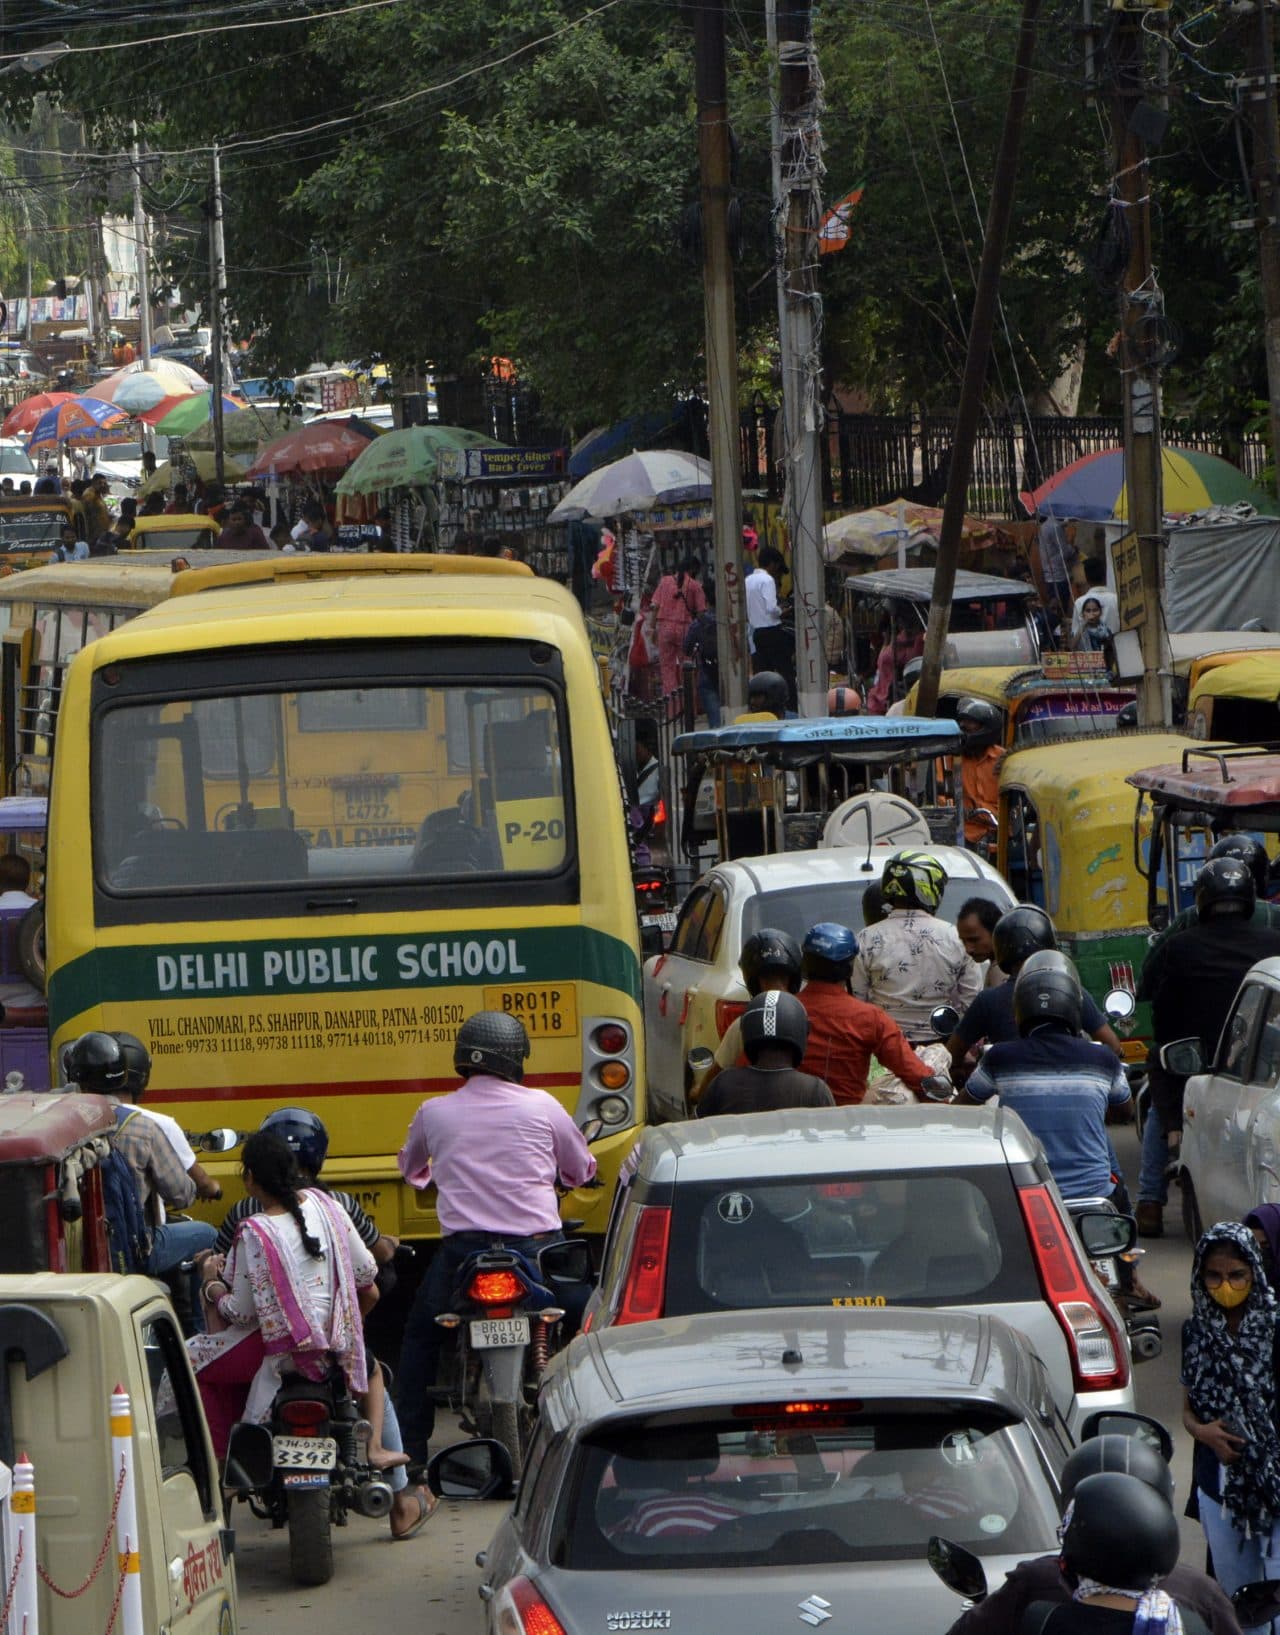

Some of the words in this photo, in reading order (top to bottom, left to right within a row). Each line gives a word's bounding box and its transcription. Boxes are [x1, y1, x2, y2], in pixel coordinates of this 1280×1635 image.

[505, 819, 564, 844] P-20
[157, 953, 248, 991] DELHI
[264, 946, 378, 986] PUBLIC
[397, 939, 526, 979] SCHOOL
[503, 991, 561, 1011] BR01P
[149, 1018, 175, 1037] VILL.
[177, 1015, 247, 1035] CHANDMARI,
[249, 1014, 265, 1033] P.S.
[267, 1011, 323, 1032] SHAHPUR,
[325, 1009, 380, 1029] DANAPUR,
[382, 1007, 418, 1026] PATNA
[151, 1041, 183, 1055] Phone:
[186, 1038, 218, 1053] 99733
[221, 1037, 255, 1053] 11118,
[257, 1035, 288, 1050] 99738
[291, 1034, 325, 1049] 11118,
[327, 1032, 359, 1047] 97714
[361, 1031, 396, 1046] 40118,
[398, 1029, 432, 1044] 97714
[482, 1320, 522, 1334] BR01D
[484, 1332, 525, 1345] Y8634
[278, 1449, 332, 1465] 3398
[284, 1474, 329, 1485] POLICE
[607, 1609, 671, 1620] MARUTI
[607, 1619, 671, 1631] SUZUKI
